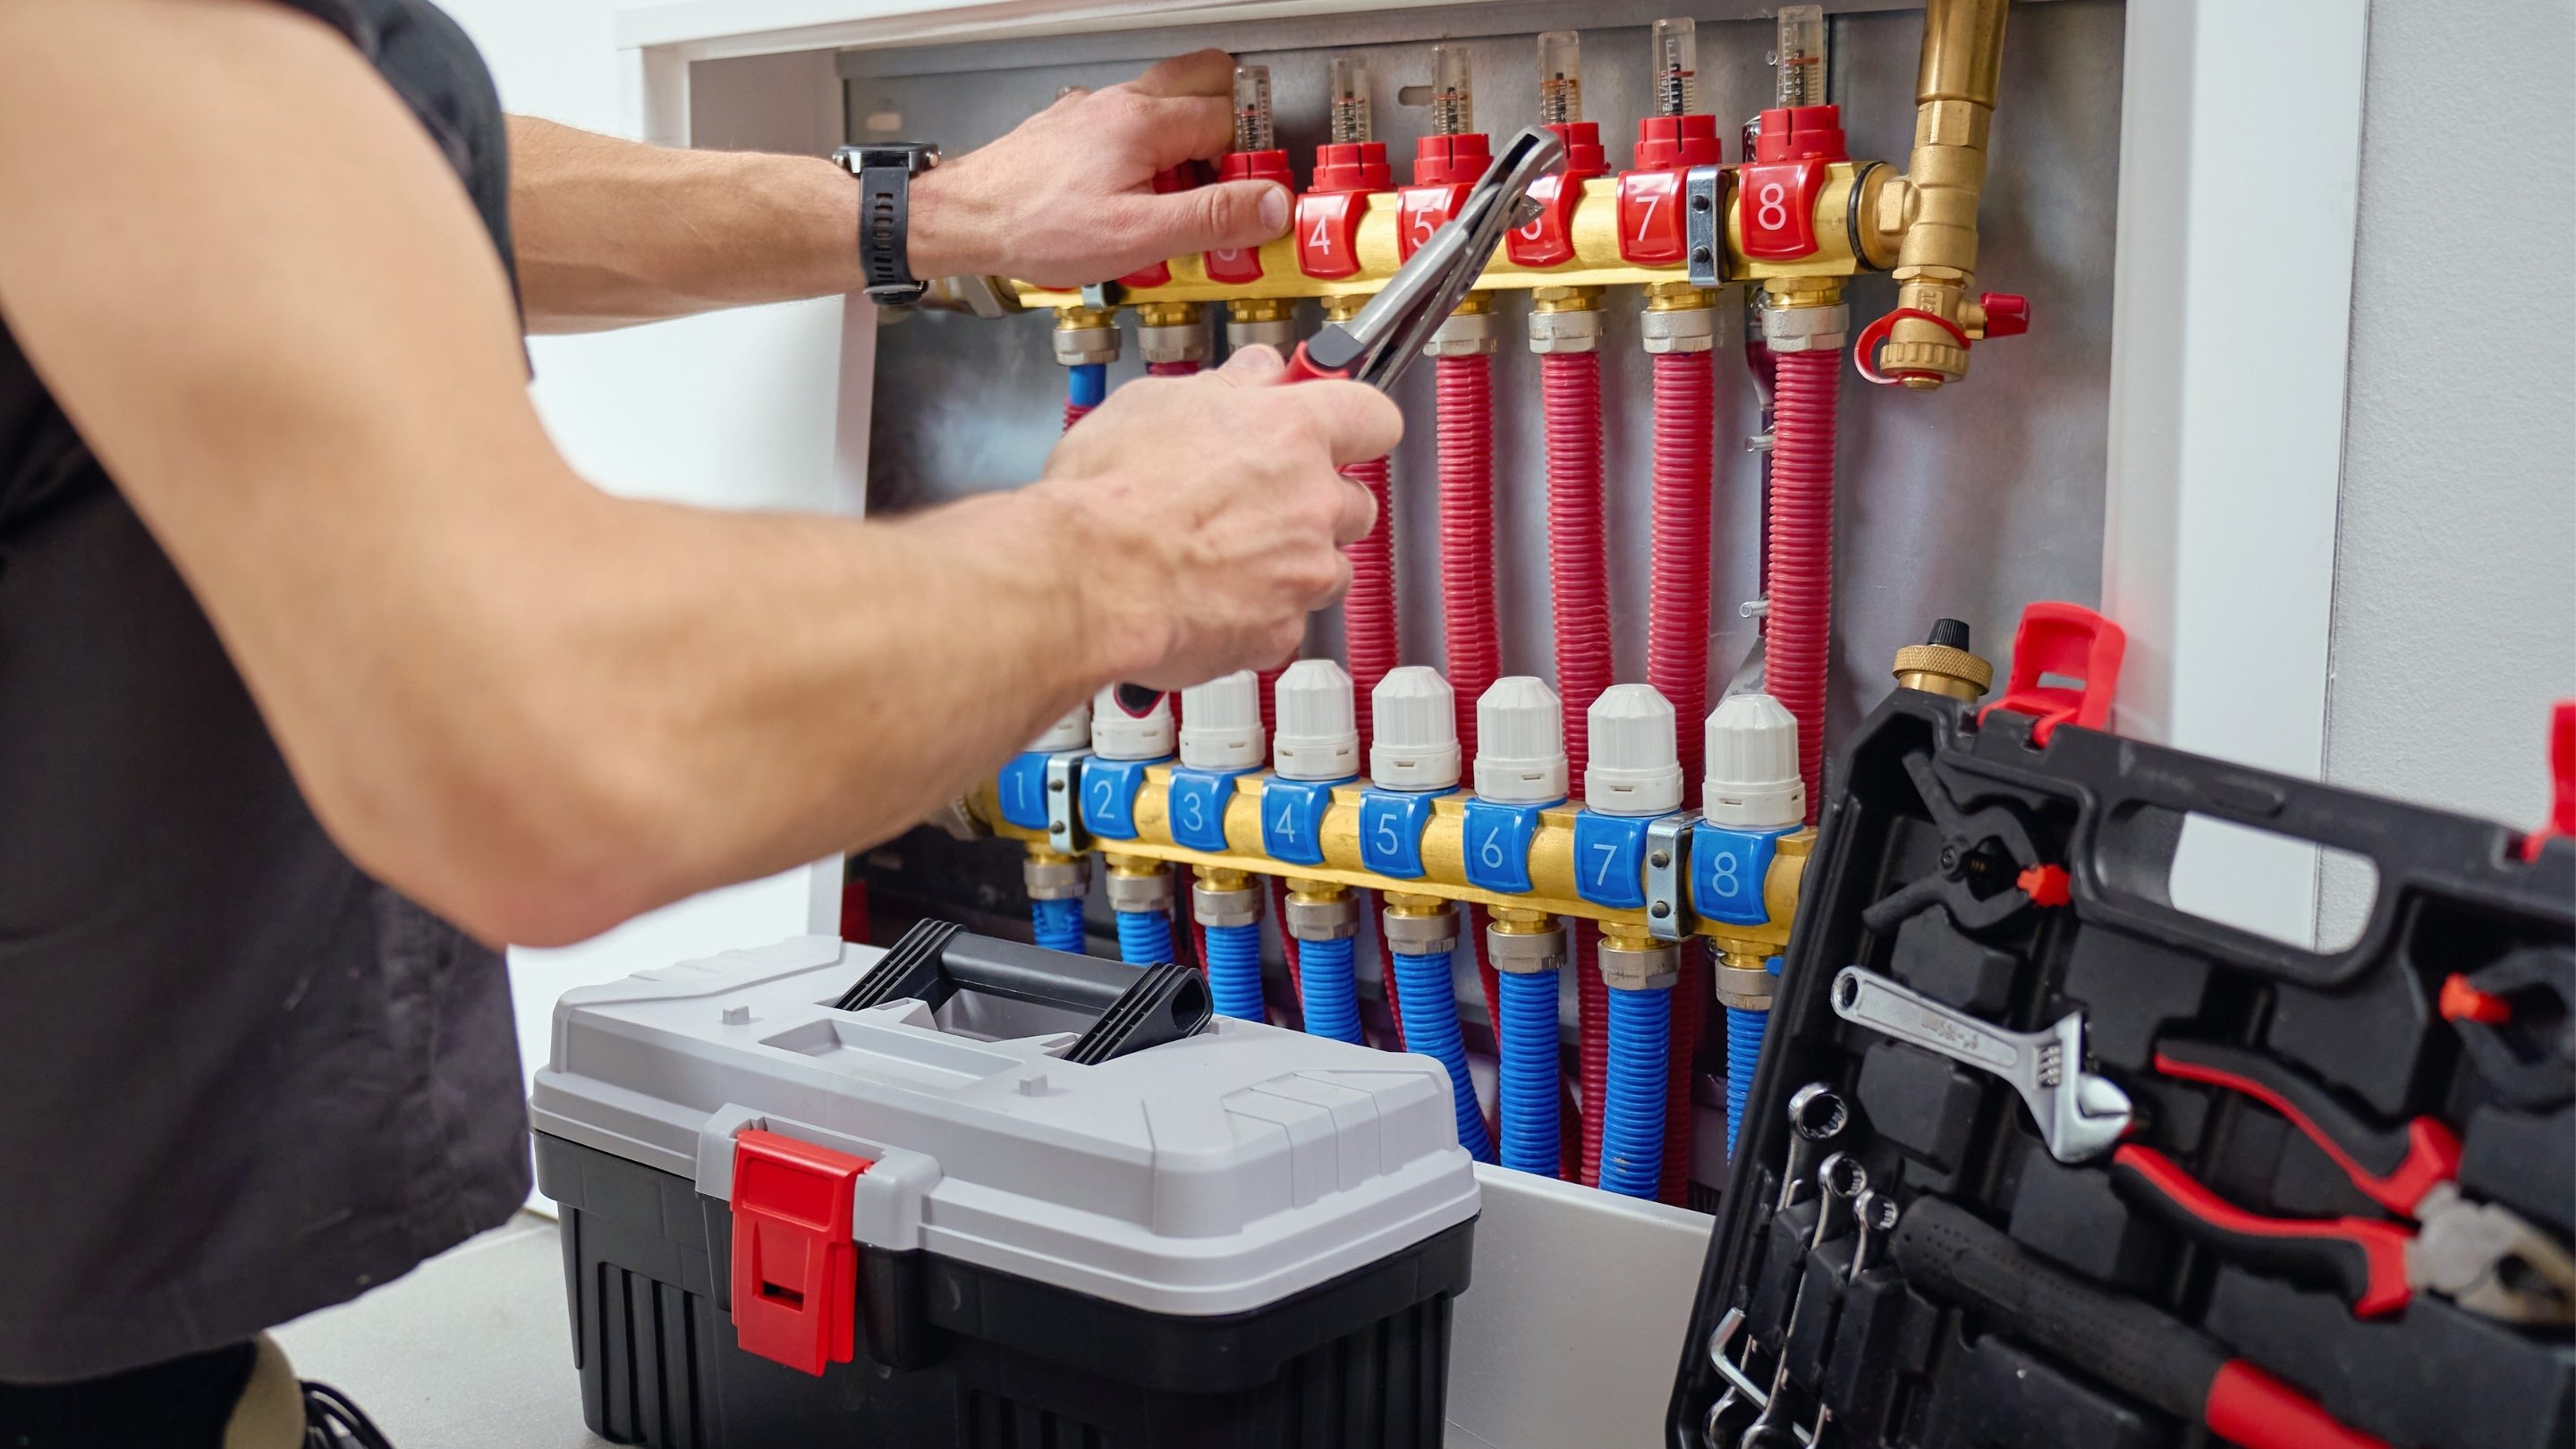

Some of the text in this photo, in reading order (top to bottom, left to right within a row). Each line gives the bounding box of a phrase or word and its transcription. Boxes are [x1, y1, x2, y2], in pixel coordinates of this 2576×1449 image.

[1635, 196, 1660, 242] 7
[1758, 182, 1786, 231] 8
[1308, 215, 1331, 255] 4
[1411, 207, 1434, 250] 5
[1015, 772, 1024, 809] 1
[1093, 780, 1114, 819] 2
[1183, 792, 1203, 831] 3
[1275, 803, 1295, 843] 4
[1376, 813, 1398, 855] 5
[1481, 826, 1503, 869] 6
[1593, 843, 1617, 886] 7
[1712, 852, 1739, 897] 8
